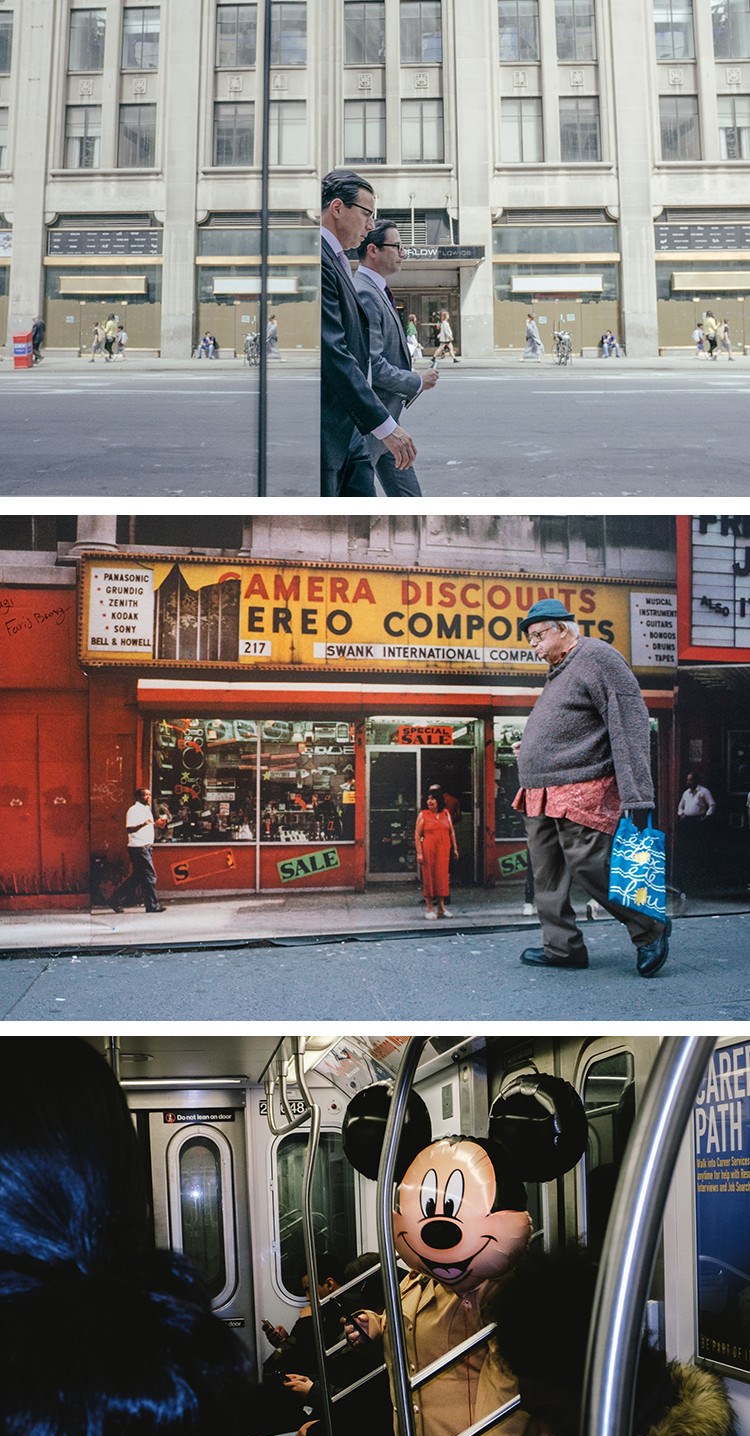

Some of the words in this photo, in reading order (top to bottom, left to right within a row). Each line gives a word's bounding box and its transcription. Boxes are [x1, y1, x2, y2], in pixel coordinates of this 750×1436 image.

[104, 573, 149, 583] PANASONIC
[106, 586, 144, 595] GRUNDIG
[219, 571, 376, 604] AMERA
[108, 599, 138, 607] ZENITH
[646, 597, 672, 606] MUSICAL
[111, 612, 139, 620] KODAK
[114, 625, 136, 633] SONY
[649, 632, 676, 640] BONGOS
[91, 637, 108, 646] BELL
[112, 637, 117, 645] &
[120, 638, 151, 646] HOWELL
[244, 642, 265, 654] 217
[326, 645, 373, 657] SWANK
[383, 646, 480, 660] INTERNATIONAL
[655, 654, 674, 662] TAPES
[403, 727, 450, 735] SPECIAL
[401, 735, 451, 745] SALE
[280, 850, 338, 880] SALE
[696, 1101, 742, 1154] PATH
